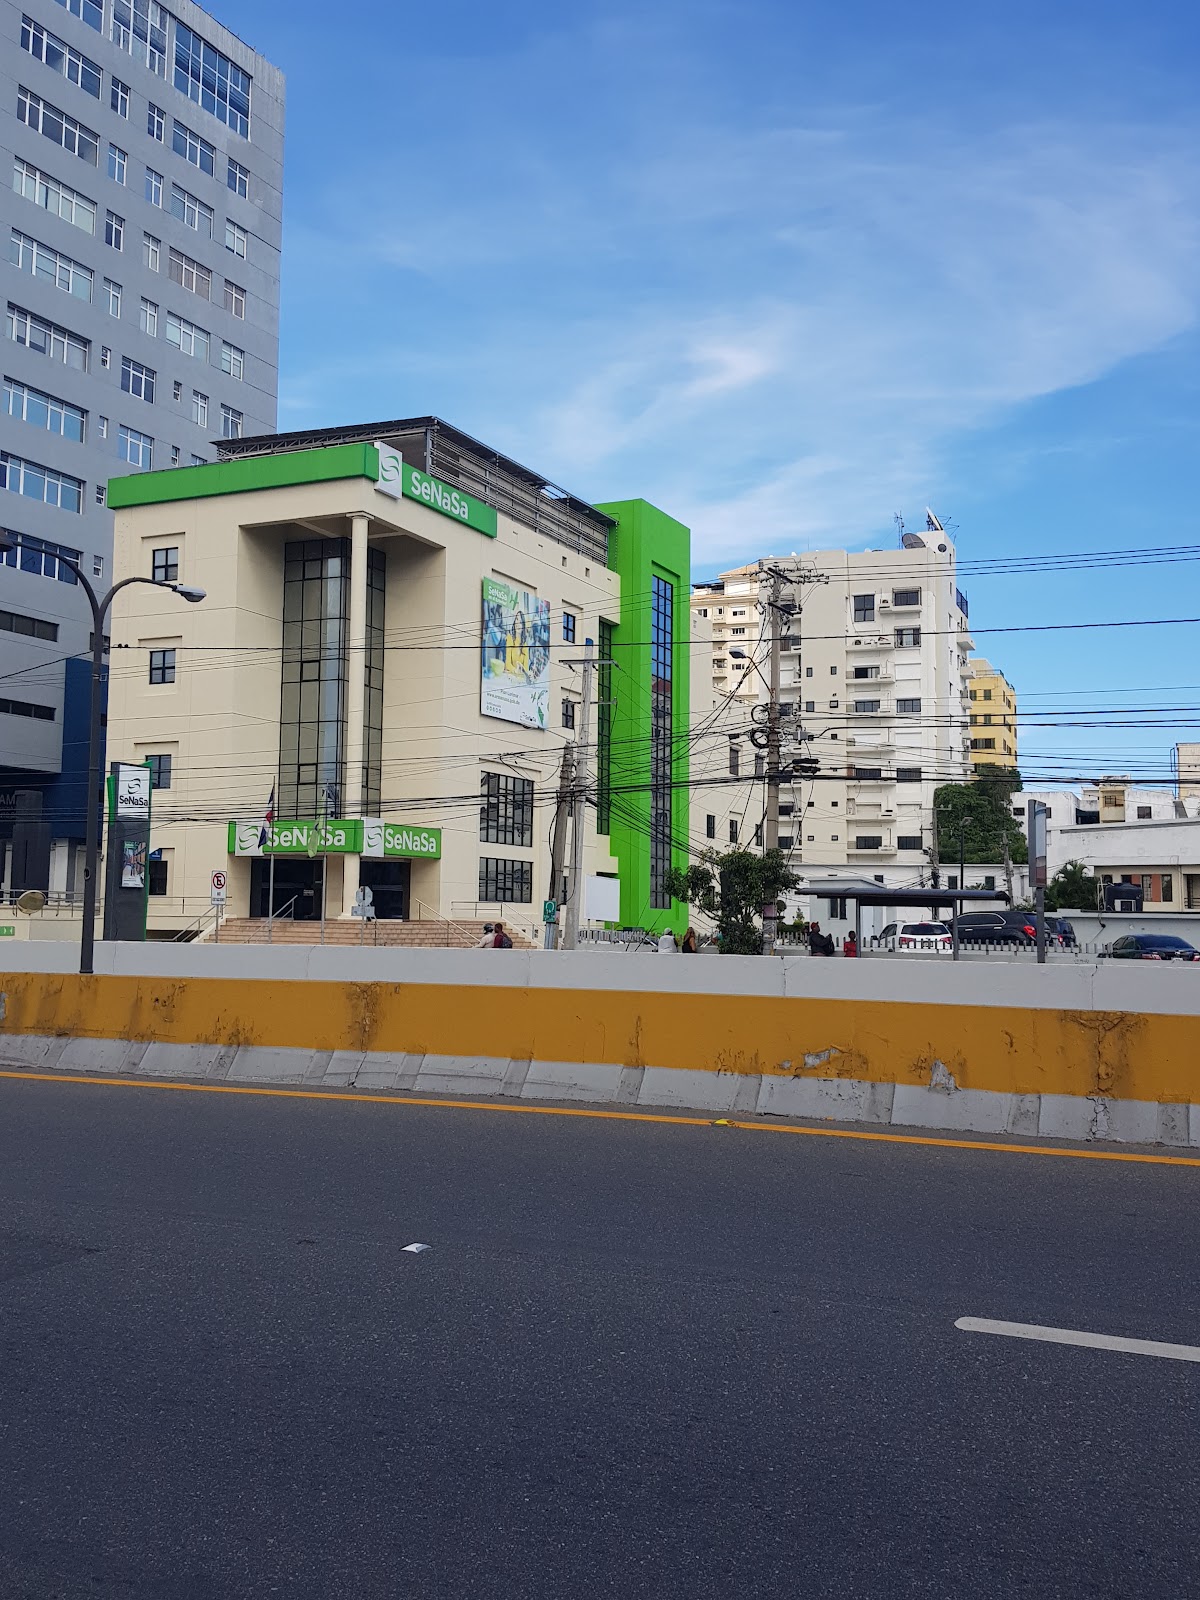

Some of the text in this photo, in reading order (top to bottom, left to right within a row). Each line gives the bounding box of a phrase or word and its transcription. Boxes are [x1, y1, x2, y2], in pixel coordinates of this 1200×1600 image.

[411, 471, 469, 520] SeNaSa
[119, 795, 149, 807] SeNaSa
[266, 825, 346, 847] SeNSa
[385, 828, 437, 853] SeNaSa
